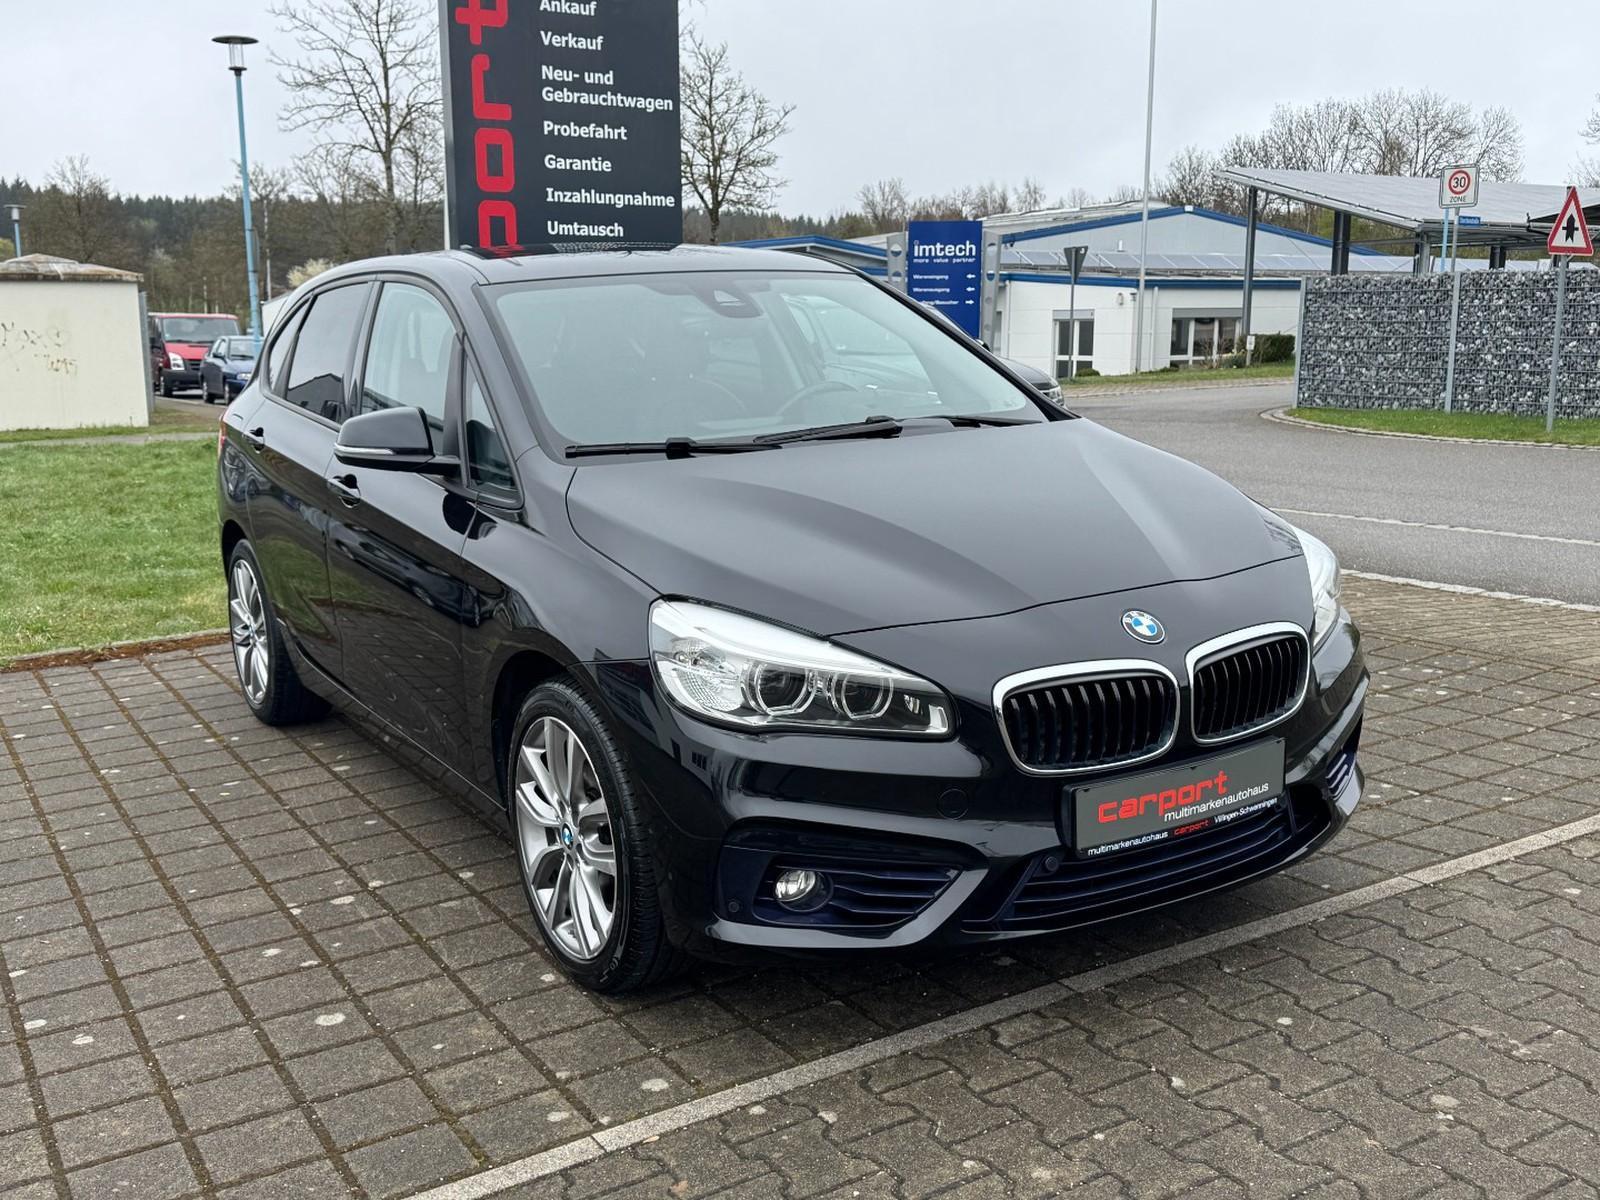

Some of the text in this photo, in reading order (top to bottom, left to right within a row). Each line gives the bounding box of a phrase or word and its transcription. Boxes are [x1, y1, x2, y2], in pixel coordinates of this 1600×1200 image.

[539, 0, 597, 16] Ankauf
[540, 30, 604, 51] Verkauf
[541, 65, 614, 85] Neu- und
[541, 87, 673, 112] Gebrauchtwagen
[543, 121, 628, 140] Probefahrt
[544, 154, 612, 171] Garantie
[1452, 176, 1467, 189] 30
[546, 187, 675, 208] Inzahlungnahme
[547, 220, 624, 237] Umtausch
[913, 240, 977, 257] imtech
[1097, 770, 1229, 823] carport
[1164, 782, 1270, 822] multimarkenautohaus
[1087, 831, 1169, 856] multimarkenautohaus
[1173, 819, 1211, 836] carport
